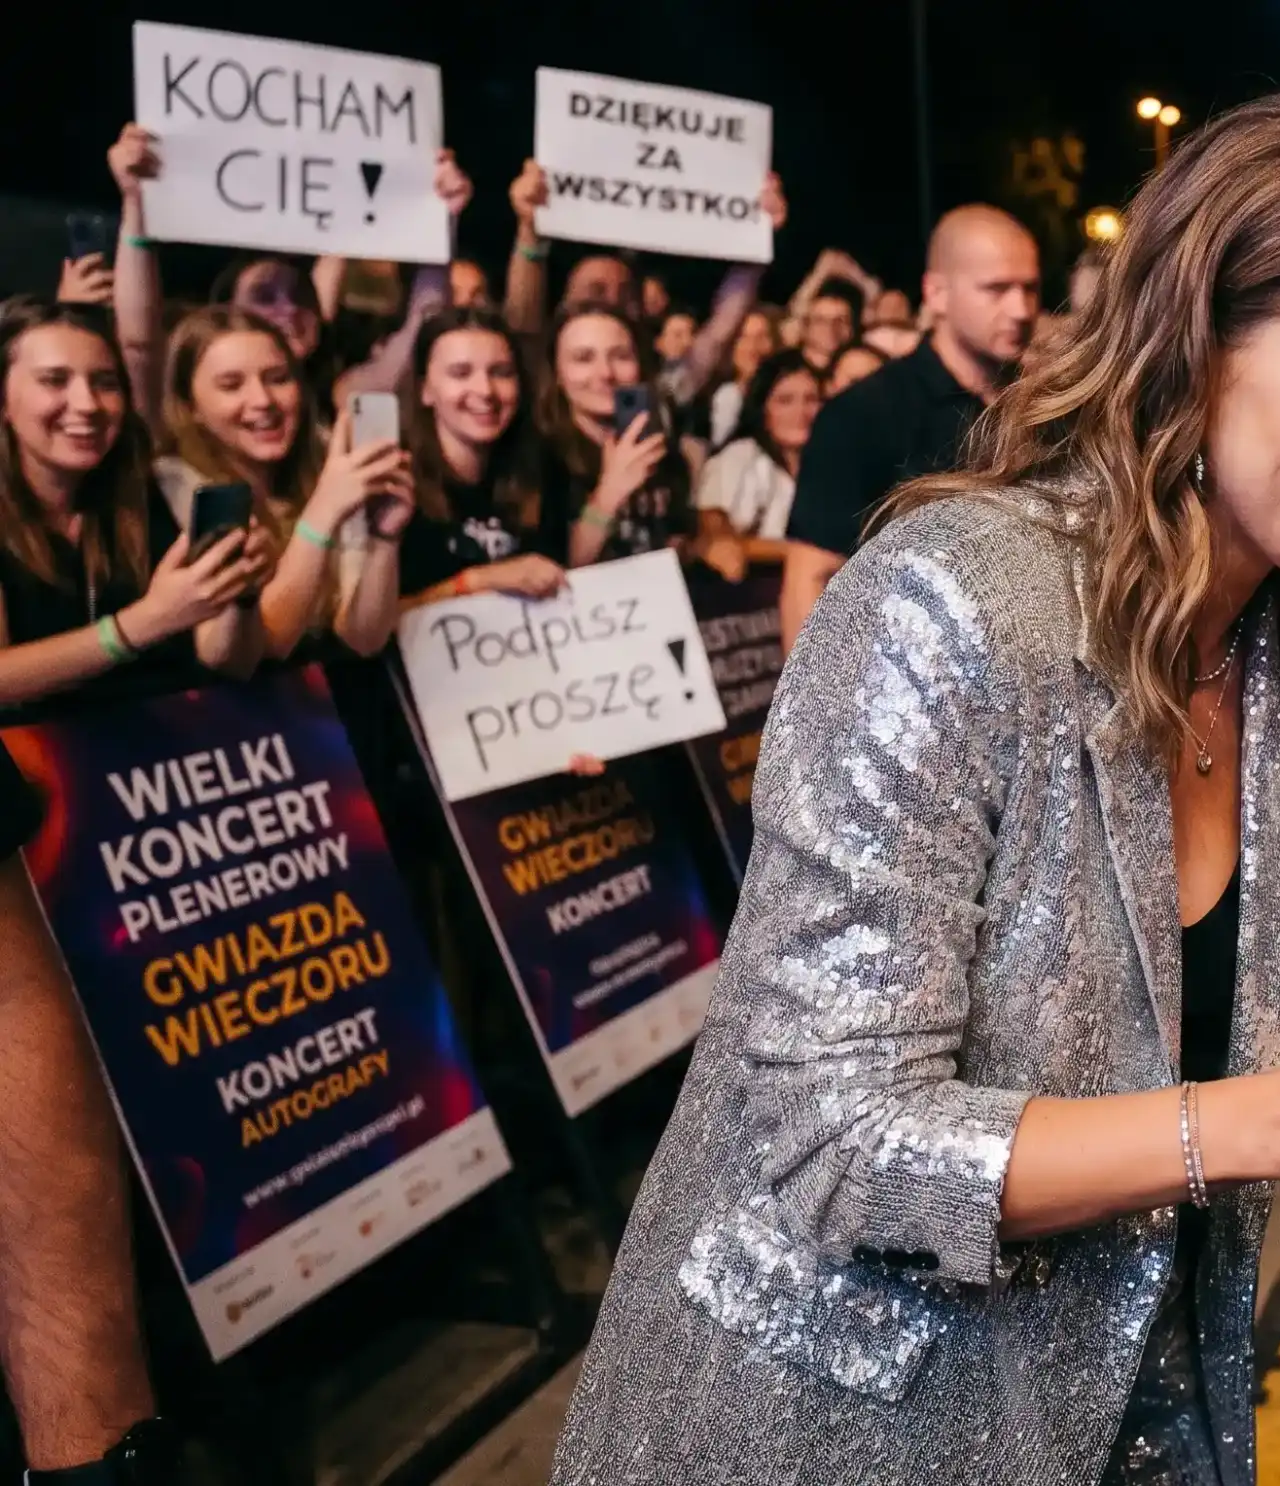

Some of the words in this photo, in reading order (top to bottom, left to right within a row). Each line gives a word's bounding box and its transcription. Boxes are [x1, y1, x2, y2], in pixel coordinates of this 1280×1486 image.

[163, 53, 416, 144] KOCHAM
[569, 94, 746, 142] DZIĘKUJE
[637, 142, 683, 172] ZA
[430, 598, 647, 674] Podpisz
[107, 733, 296, 822] WIELKI
[98, 781, 332, 892] KONCERT
[118, 833, 350, 943] PLENEROWY
[142, 891, 367, 1006] GWIAZDA
[144, 931, 391, 1067] WIECZORU
[215, 1007, 380, 1115] KONCERT
[240, 1049, 390, 1148] AUTOGRAFY
